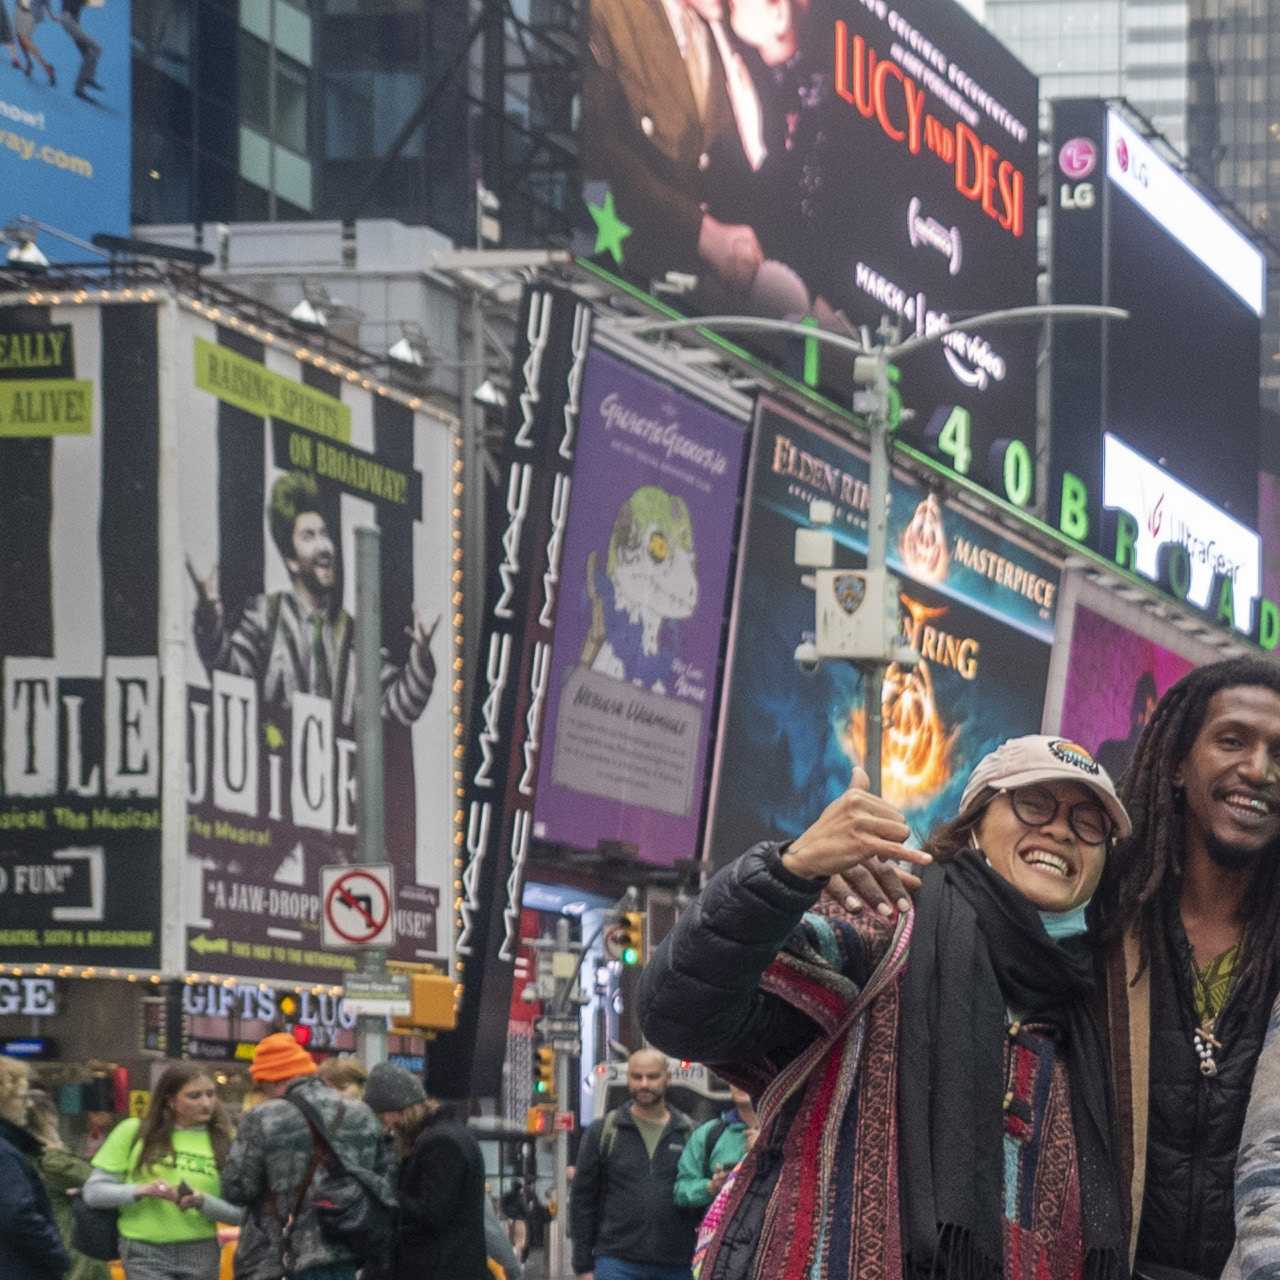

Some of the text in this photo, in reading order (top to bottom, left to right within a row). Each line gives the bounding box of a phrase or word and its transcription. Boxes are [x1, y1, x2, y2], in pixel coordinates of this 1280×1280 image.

[887, 10, 947, 74] ORIGINAL
[947, 62, 1028, 143] DOCUMENTARY
[835, 20, 1023, 237] LUCY AND DESI
[1060, 182, 1096, 210] LG
[1131, 152, 1148, 188] LG
[855, 262, 906, 315] MARCH
[903, 296, 915, 322] 4
[965, 335, 1006, 381] video
[772, 434, 840, 497] ELDEN
[921, 624, 979, 681] RING
[227, 884, 320, 922] JAW-DROPP
[184, 984, 277, 1022] GIFTS
